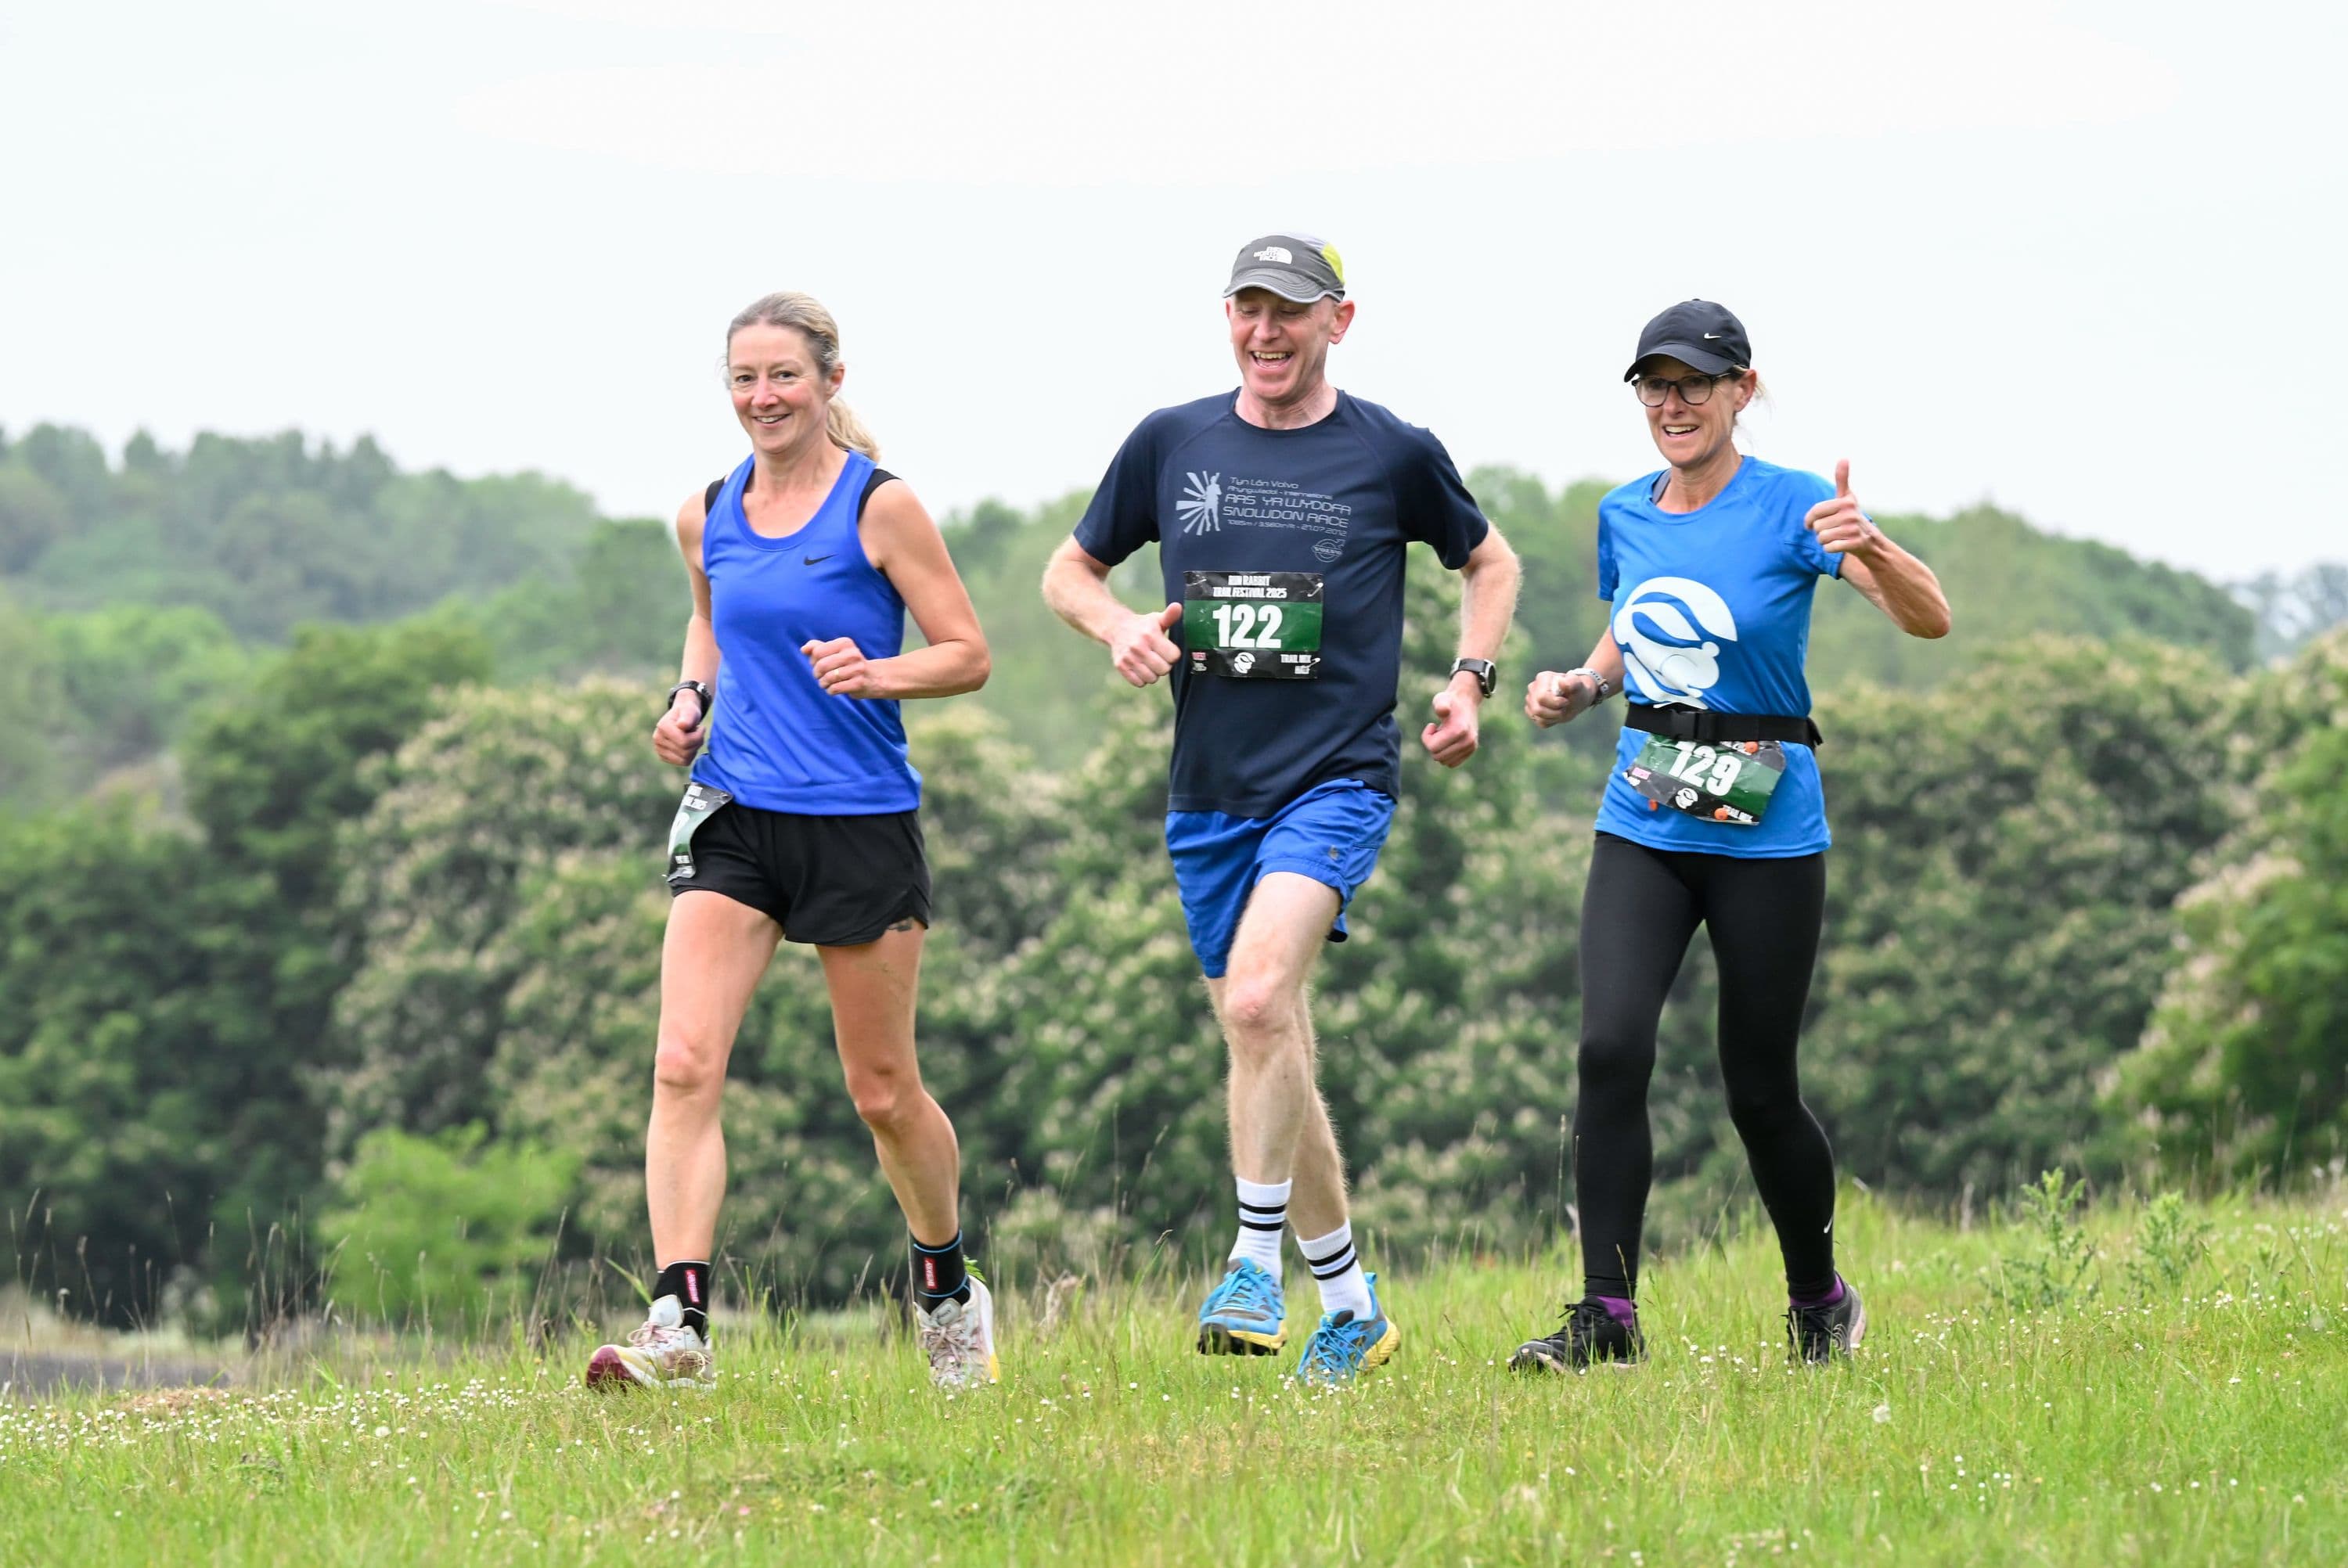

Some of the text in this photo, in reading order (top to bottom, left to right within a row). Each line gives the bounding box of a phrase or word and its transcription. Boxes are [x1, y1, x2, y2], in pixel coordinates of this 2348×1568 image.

[1230, 477, 1249, 485] Tyn
[1270, 480, 1299, 489] Volvo
[1225, 494, 1352, 516] RAS YR WYDDFA
[1222, 506, 1350, 528] SNOWDON RACE
[1301, 523, 1348, 537] 21.07.2012
[1266, 588, 1288, 599] 2025
[1212, 603, 1284, 649] 122
[1668, 741, 1742, 797] 129
